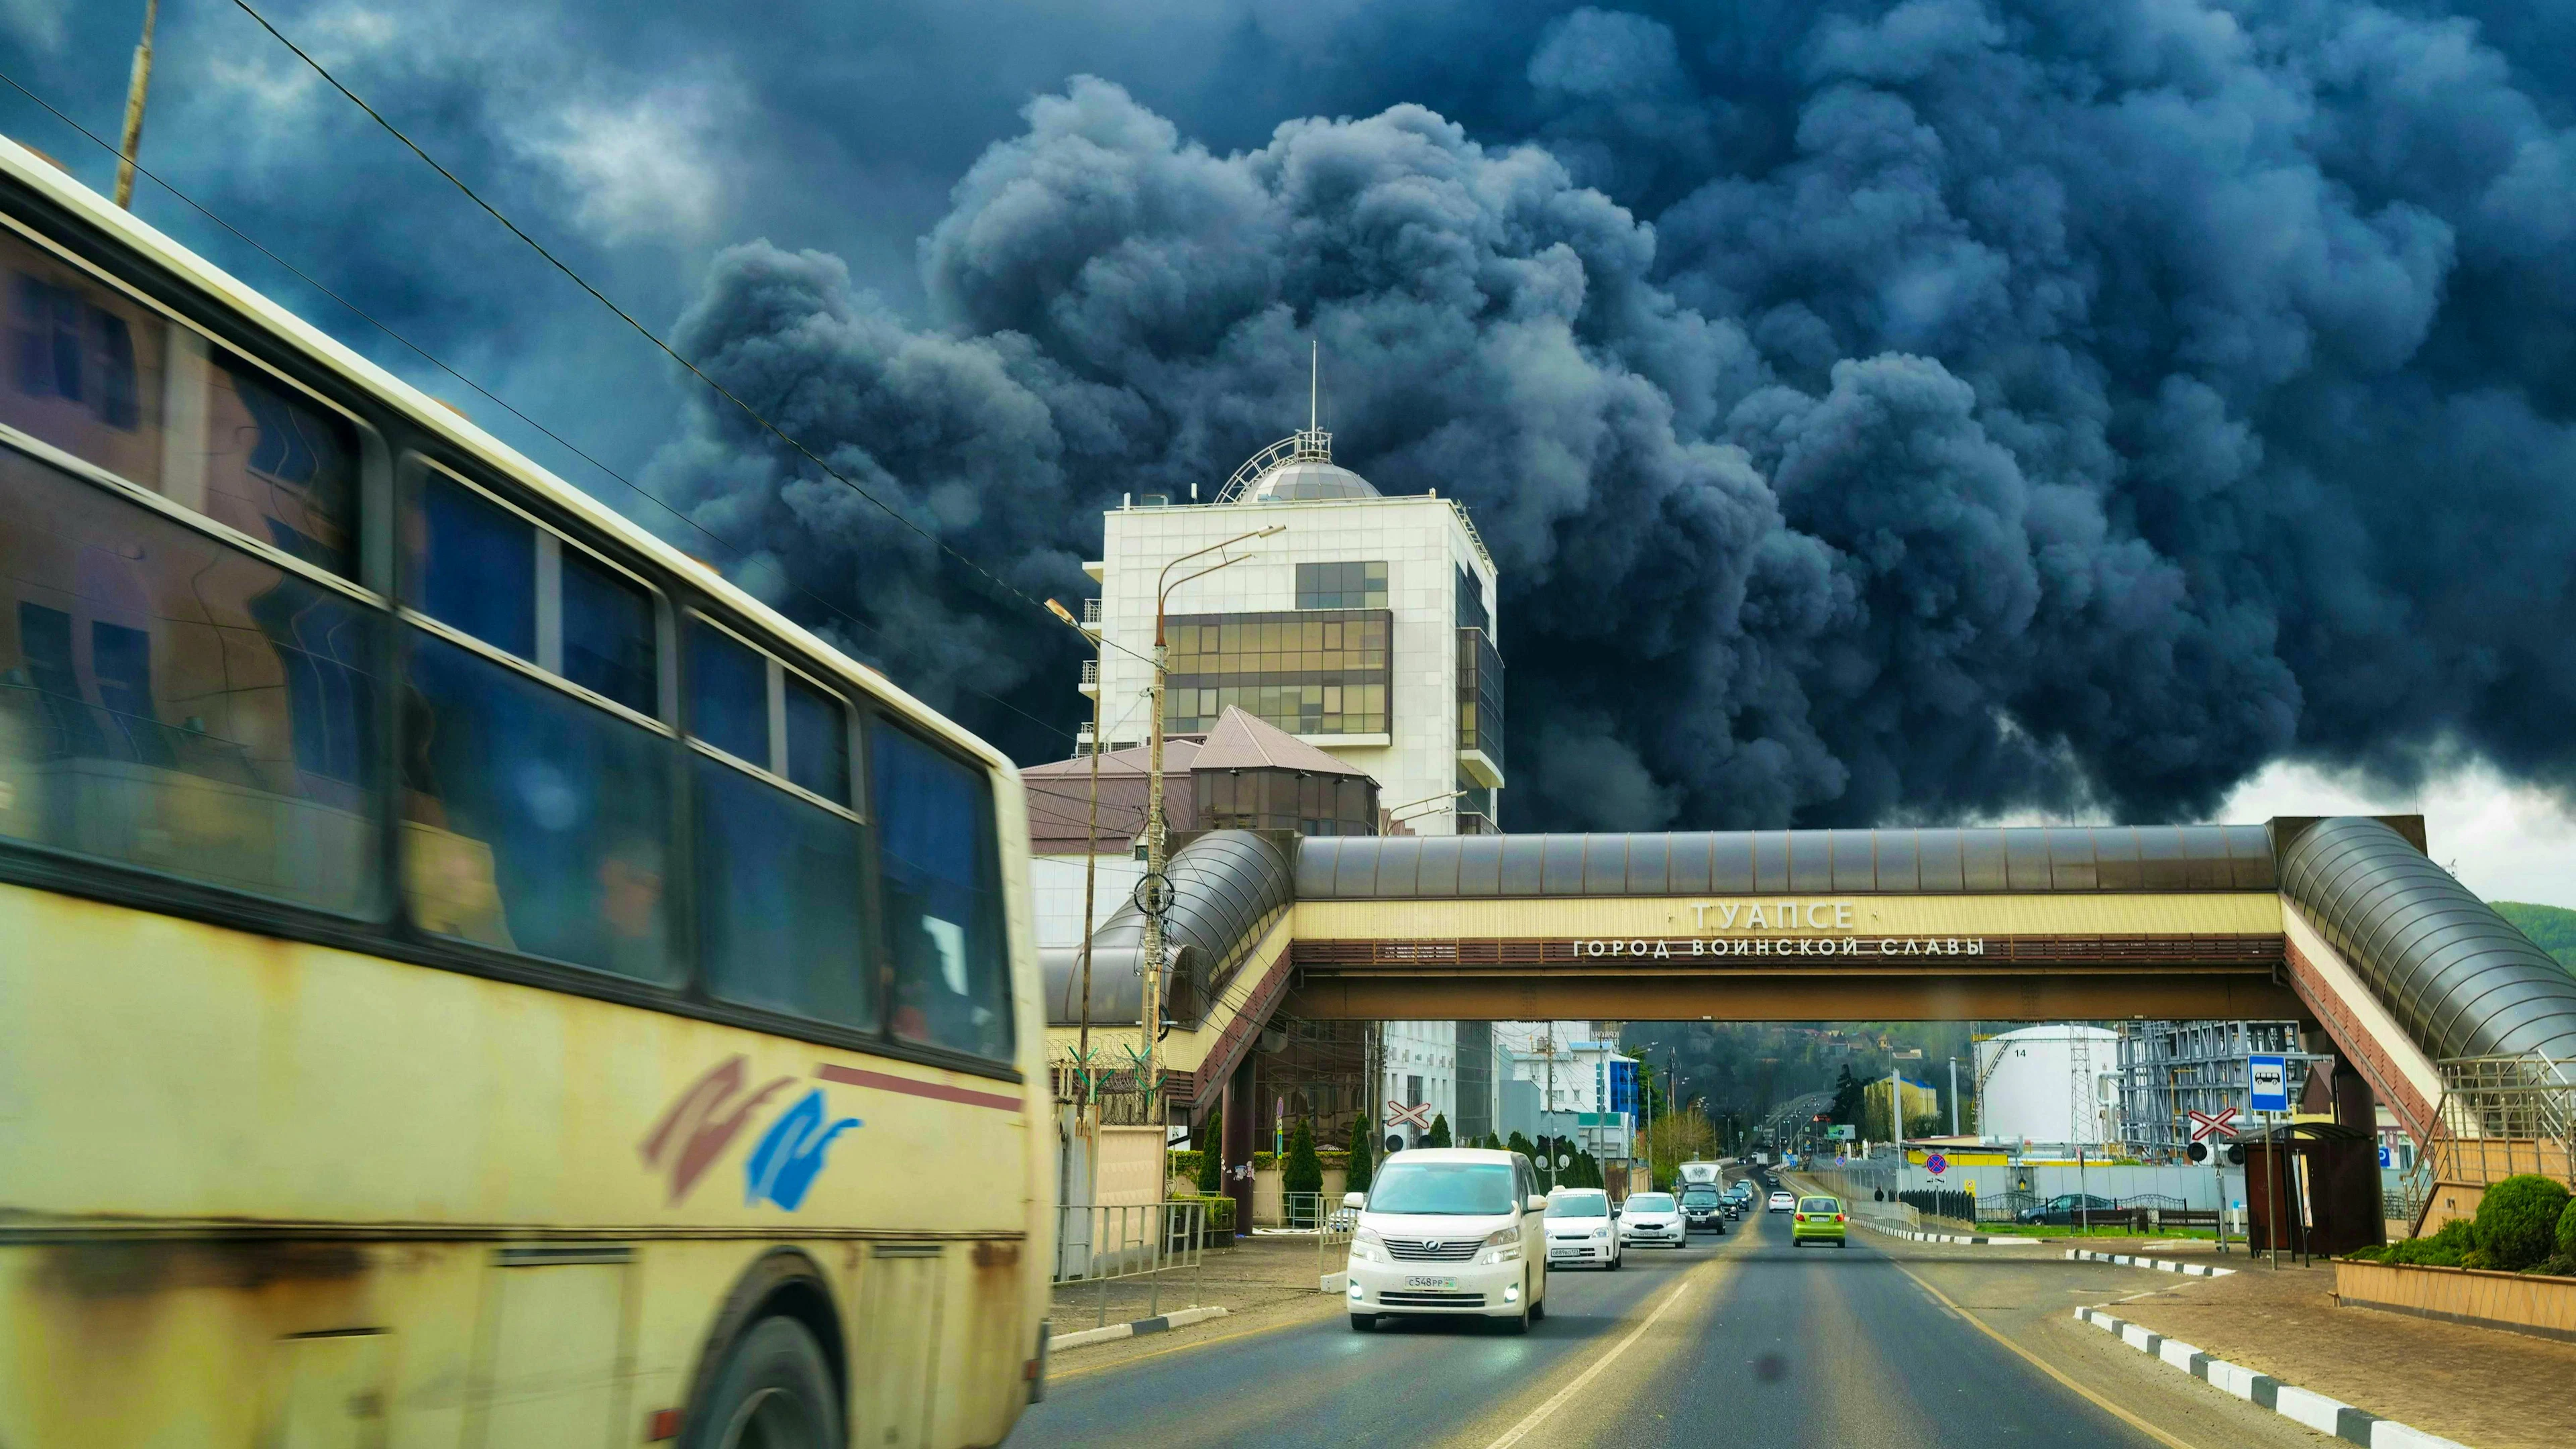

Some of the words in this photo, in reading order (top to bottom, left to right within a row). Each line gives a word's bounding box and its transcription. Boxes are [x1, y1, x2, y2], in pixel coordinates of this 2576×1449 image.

[1690, 902, 1854, 930] ТУАПСЕ
[1574, 940, 1670, 959] ГОРОД
[1693, 937, 1858, 956] ВОИНСКОЙ
[1880, 938, 1984, 956] СЛАВЫ
[2015, 1049, 2026, 1057] 14
